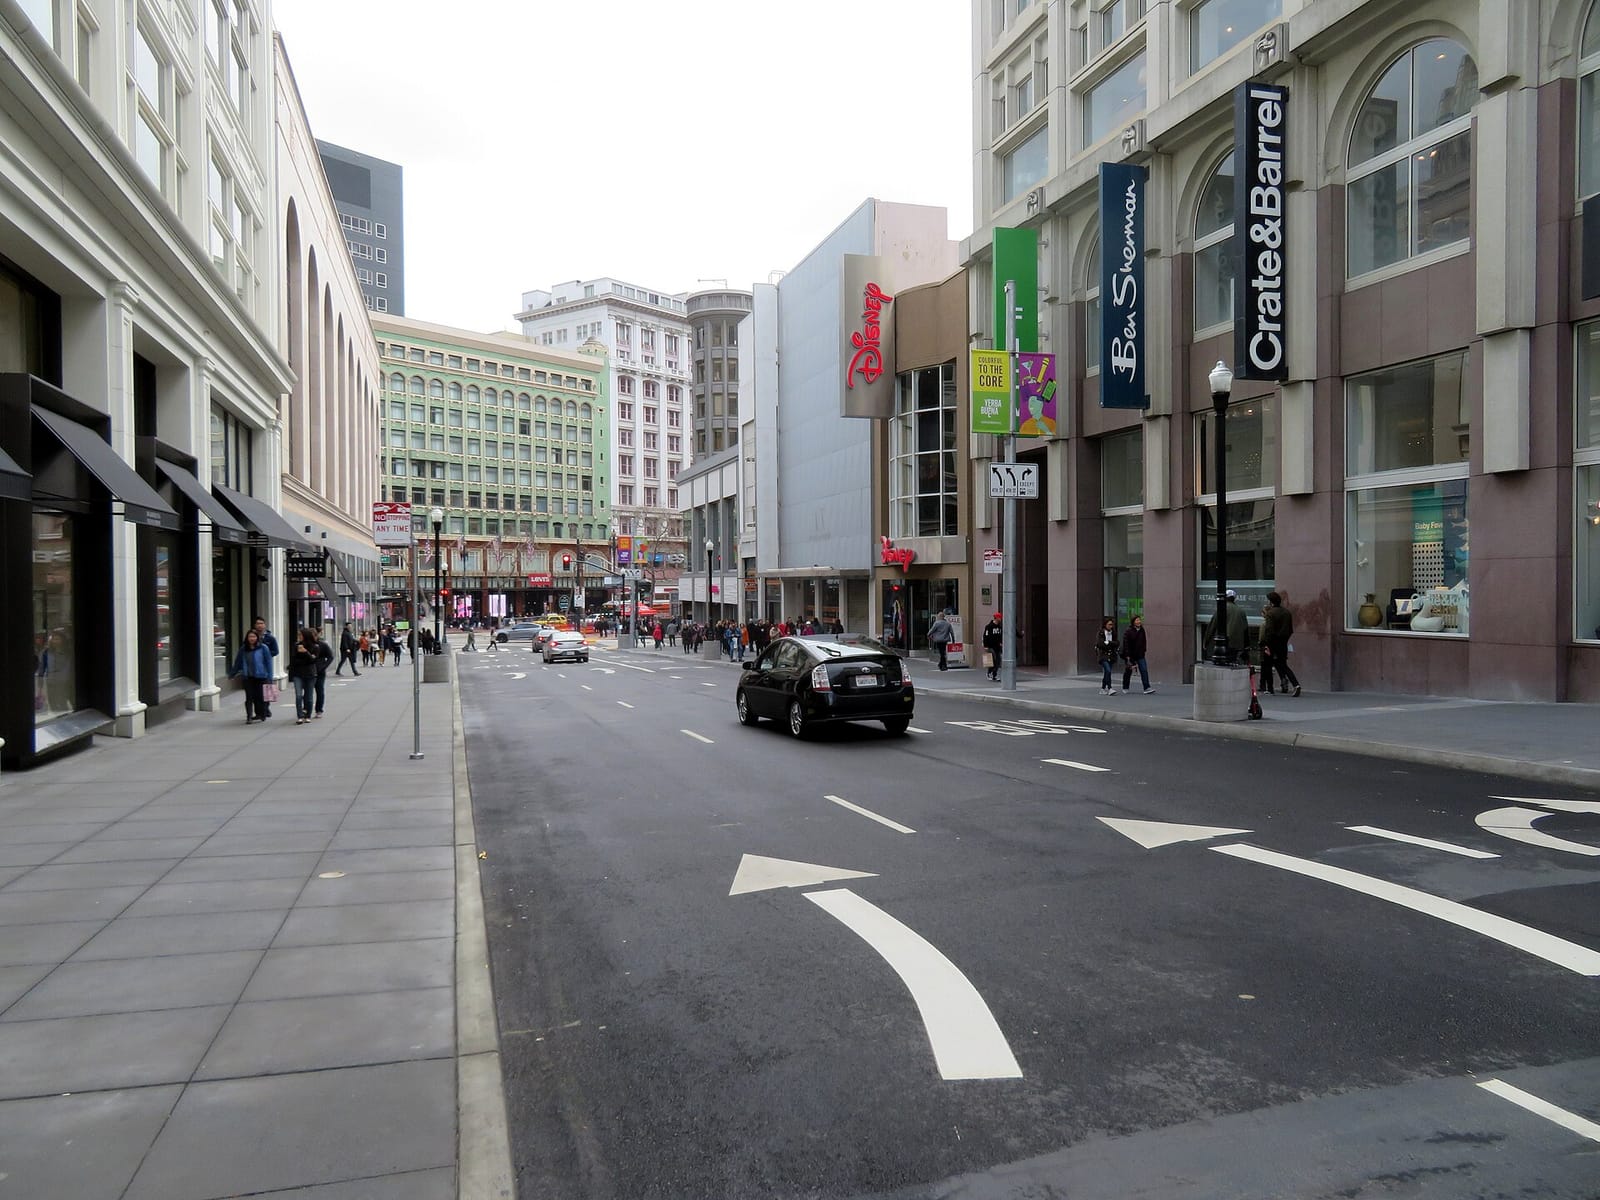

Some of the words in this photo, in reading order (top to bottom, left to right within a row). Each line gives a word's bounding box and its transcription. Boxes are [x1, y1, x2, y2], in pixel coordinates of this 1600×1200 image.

[1250, 89, 1282, 370] Crate&Barrel
[1112, 179, 1137, 309] Sherman
[1111, 311, 1137, 383] Ben
[978, 356, 1002, 364] COLORFUL
[979, 364, 988, 373] TO
[990, 364, 1003, 374] THE
[979, 375, 1004, 387] CORE
[944, 719, 1107, 736] BUS
